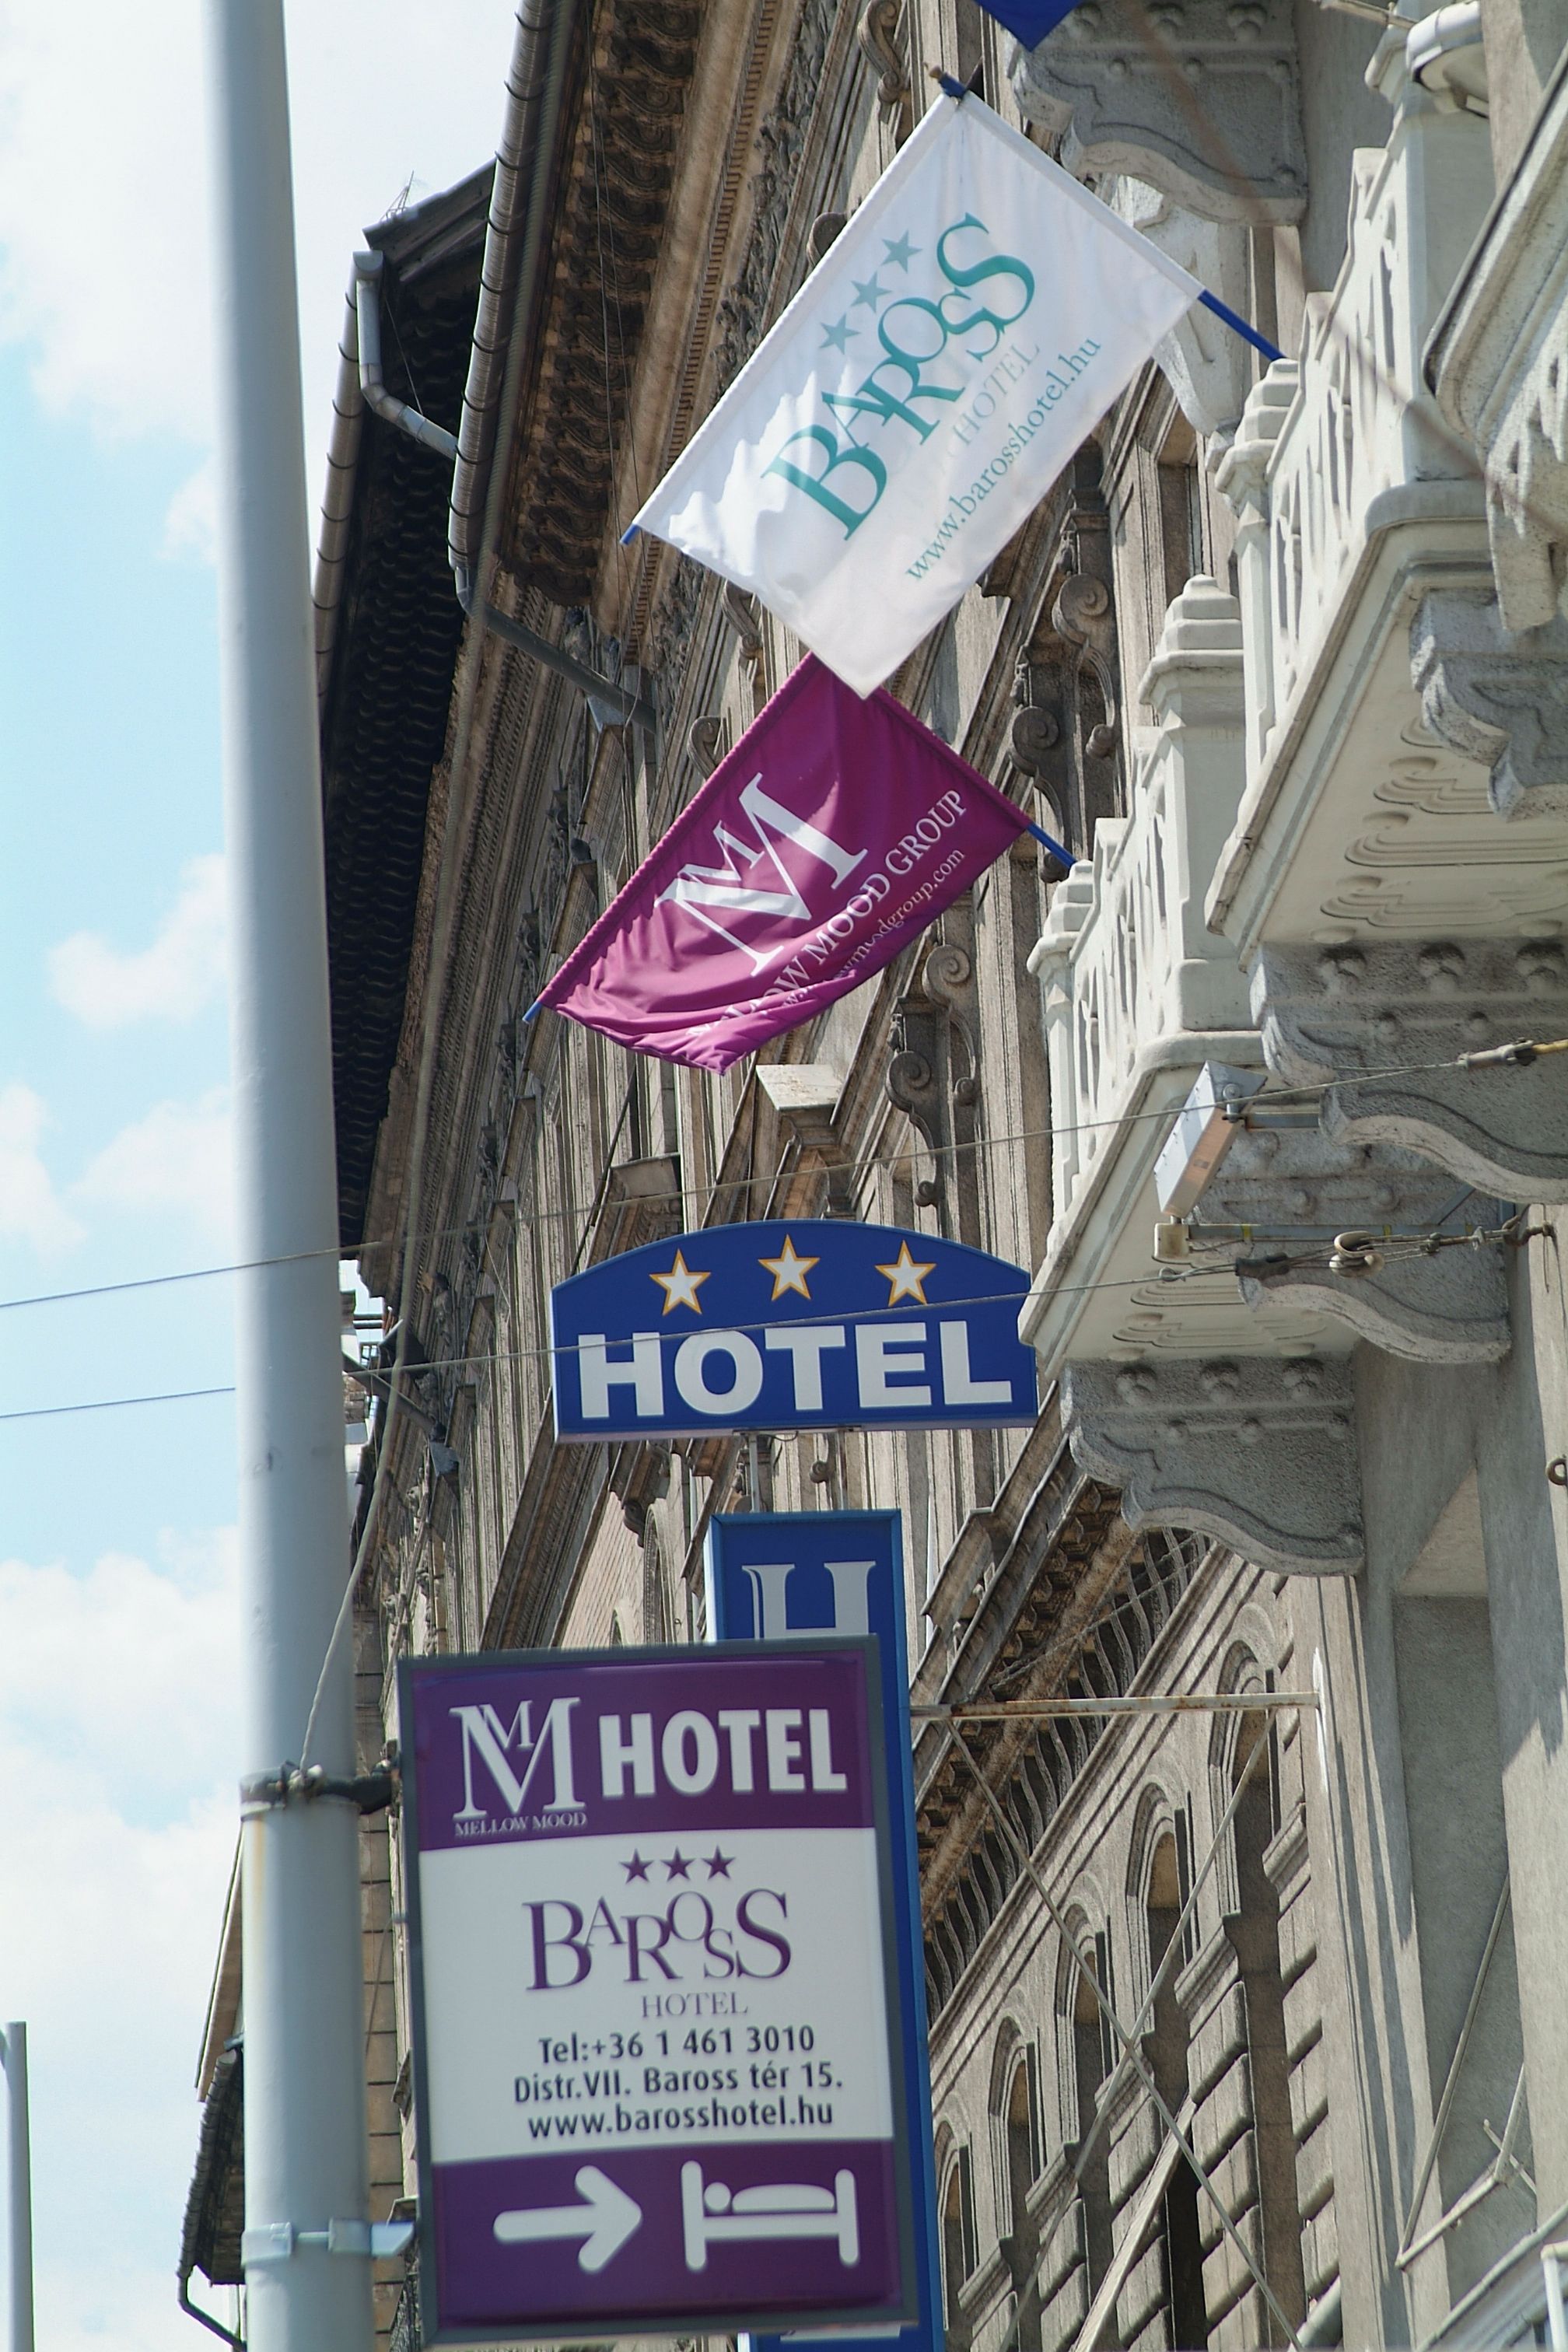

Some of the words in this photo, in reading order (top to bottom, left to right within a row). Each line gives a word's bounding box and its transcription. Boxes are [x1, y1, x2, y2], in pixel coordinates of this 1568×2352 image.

[760, 212, 1036, 542] BAROSS
[952, 344, 1041, 446] HOTEL
[905, 338, 1101, 581] www.barosshotel.hu
[801, 873, 891, 966] MOOD
[884, 789, 966, 876] GROUP
[578, 1320, 1012, 1419] HOTEL
[599, 1709, 849, 1798] HOTEL
[454, 1815, 530, 1838] MELLOW
[532, 1811, 587, 1829] MOOD
[522, 1888, 793, 1992] BAROSS
[539, 2030, 644, 2064] Tel:+36
[656, 2030, 669, 2056] 1
[682, 2028, 733, 2055] 461
[746, 2025, 815, 2053] 3010
[642, 1992, 749, 2018] HOTEL
[527, 2094, 834, 2139] www.barosshotel.hu
[643, 2065, 739, 2094] Baross
[749, 2059, 789, 2089] tér
[801, 2060, 844, 2088] 15.
